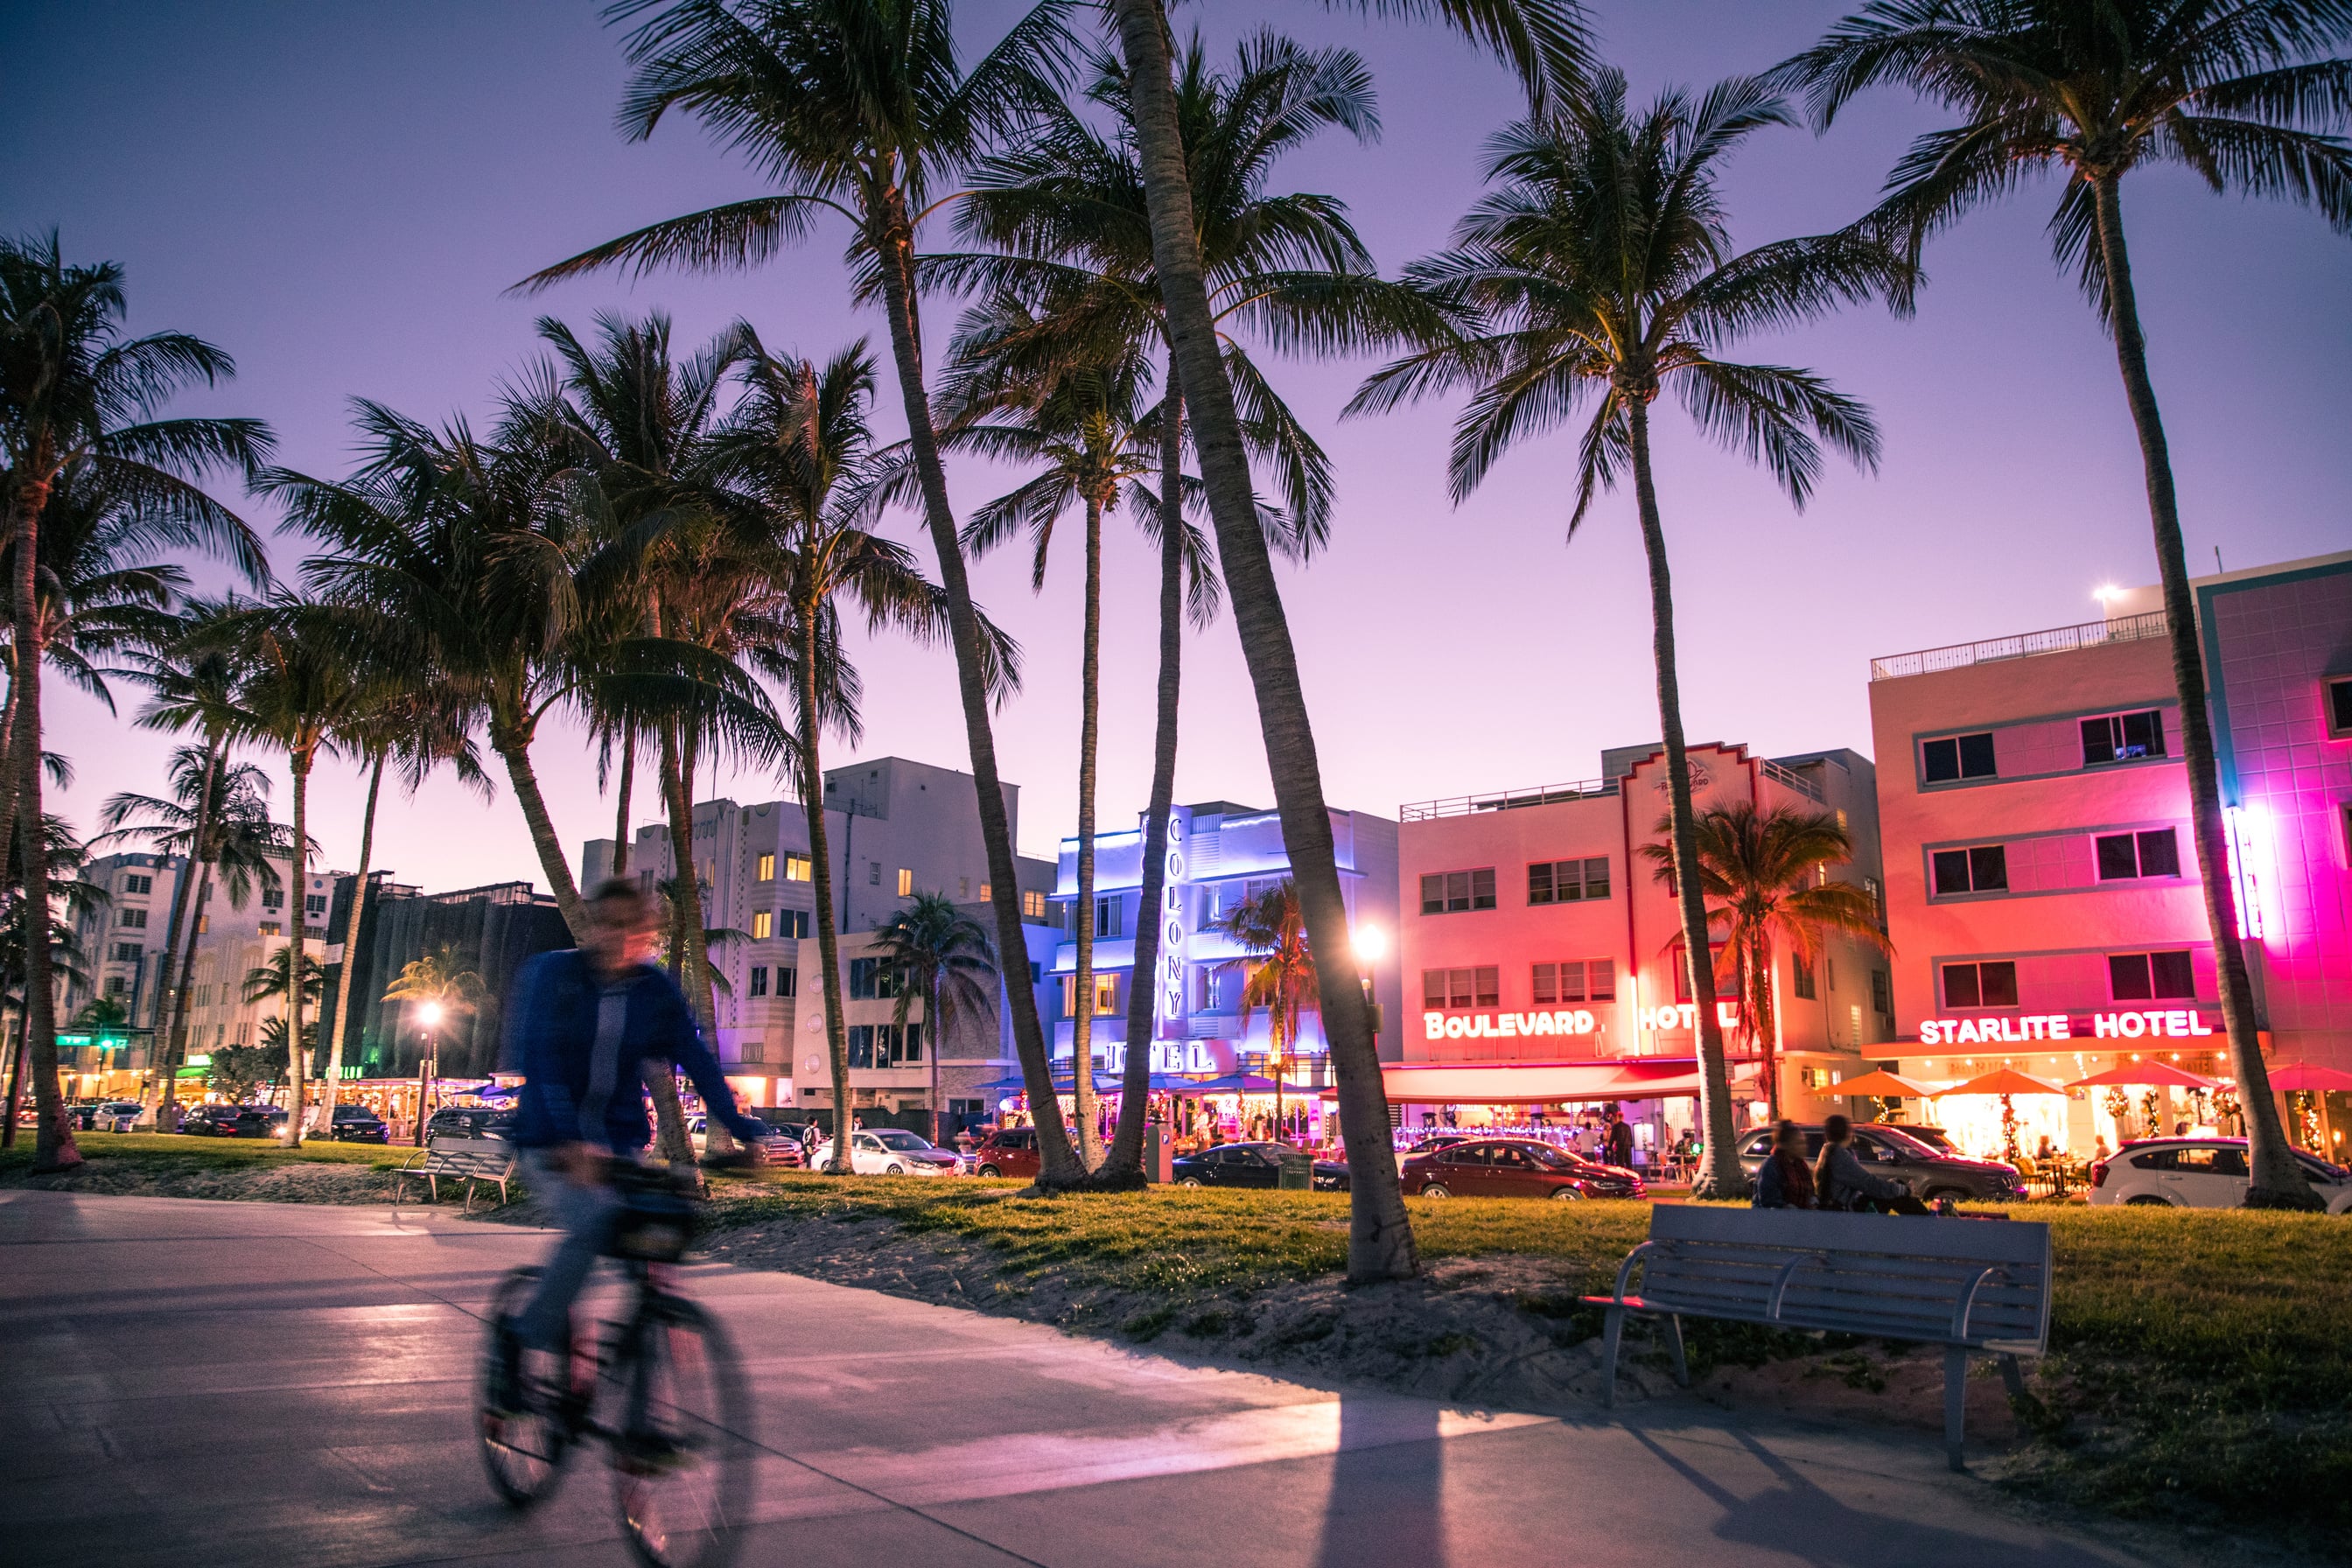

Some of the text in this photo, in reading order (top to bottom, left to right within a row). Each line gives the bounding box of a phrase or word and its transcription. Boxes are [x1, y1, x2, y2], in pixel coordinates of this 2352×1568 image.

[1169, 818, 1183, 1016] COLONY
[1424, 1002, 1740, 1040] BOULEVARD HOTL
[1920, 1010, 2212, 1044] STARLITE HOTEL
[325, 1066, 362, 1079] ALON
[1106, 1045, 1212, 1069] HOEL
